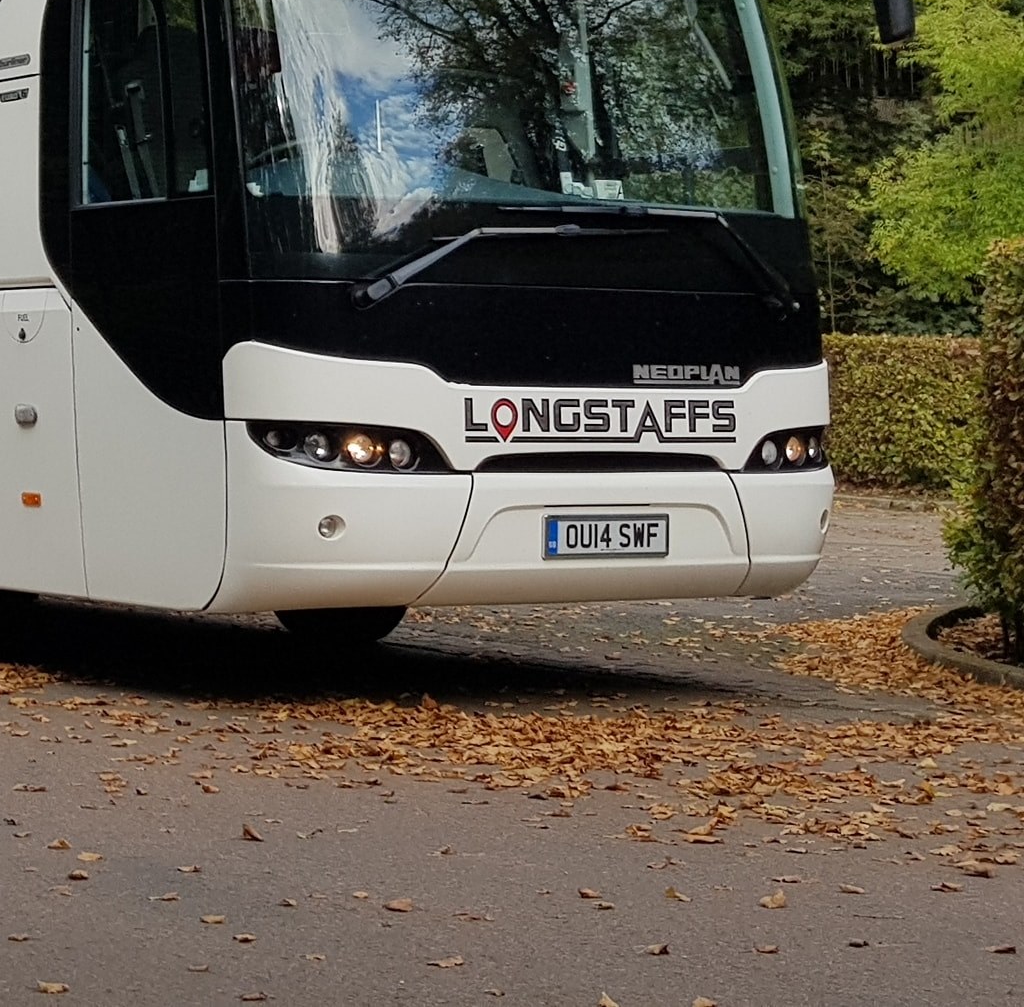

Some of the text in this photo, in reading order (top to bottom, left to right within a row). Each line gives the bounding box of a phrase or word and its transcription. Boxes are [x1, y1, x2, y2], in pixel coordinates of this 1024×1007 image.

[632, 363, 741, 386] NEOPLAN
[464, 397, 737, 443] LONGSTAFFS
[566, 522, 659, 549] OU14 SWF
